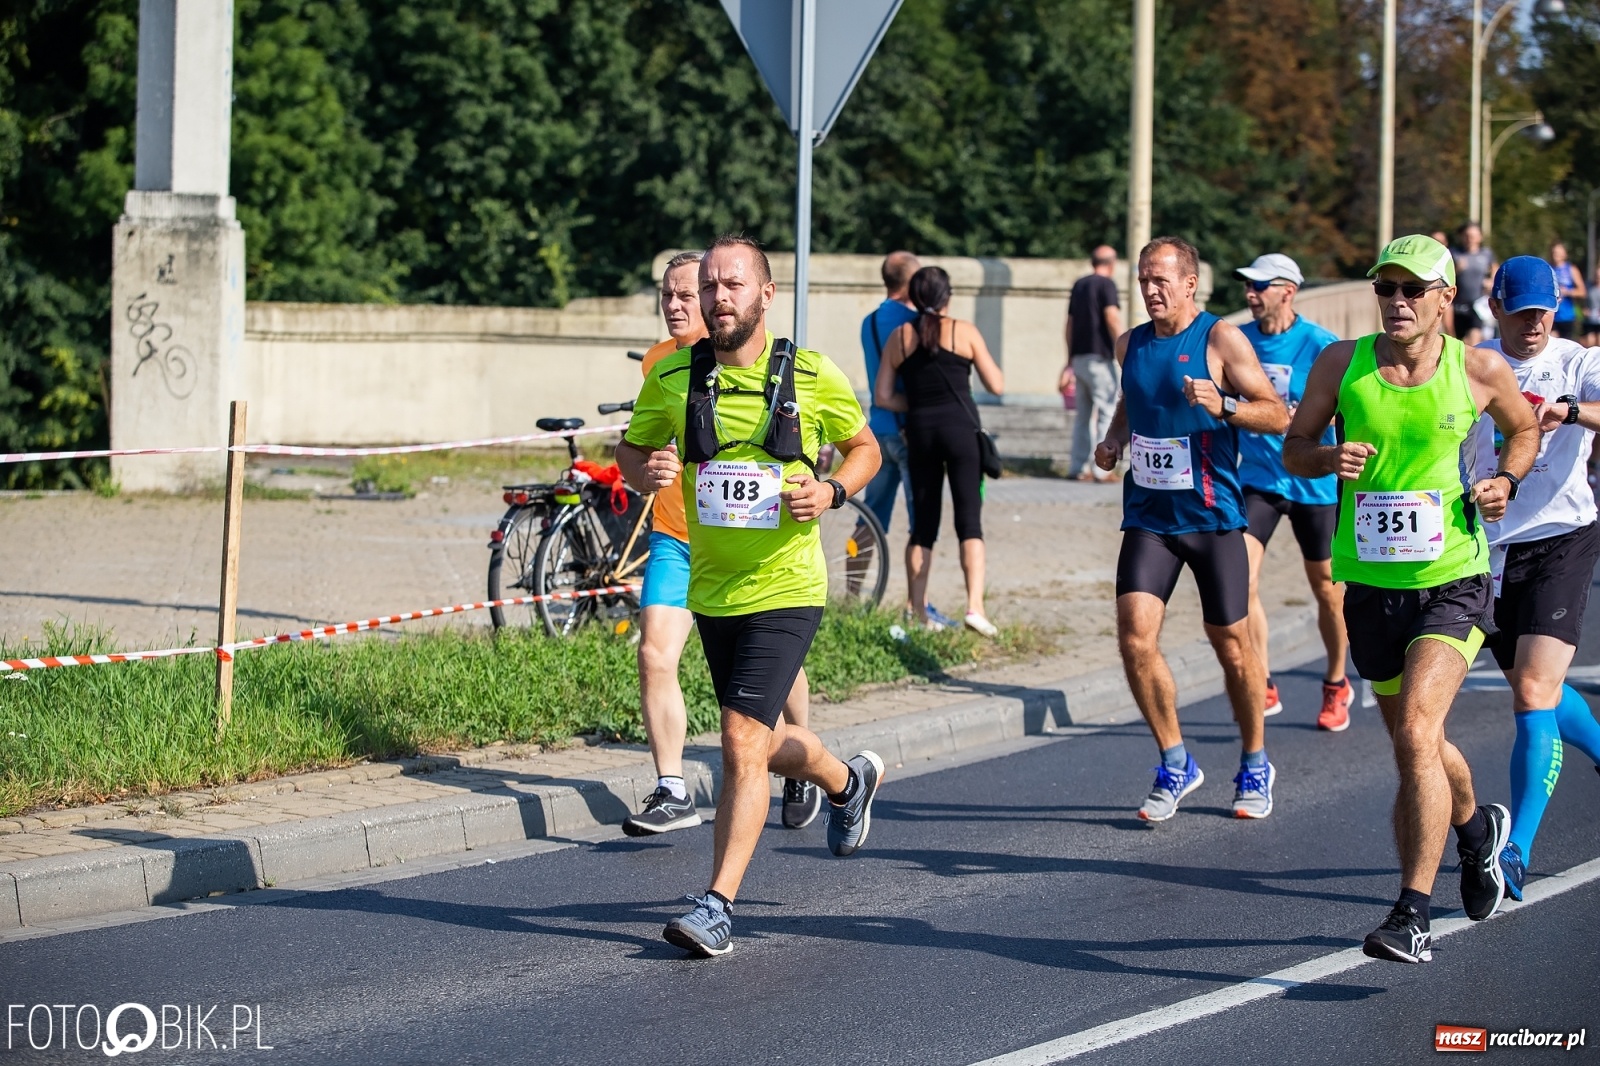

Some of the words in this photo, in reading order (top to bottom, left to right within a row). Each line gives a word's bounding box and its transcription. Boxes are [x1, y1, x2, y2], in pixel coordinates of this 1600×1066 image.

[1145, 452, 1174, 469] 182
[721, 479, 760, 501] 183
[1377, 511, 1418, 533] 351
